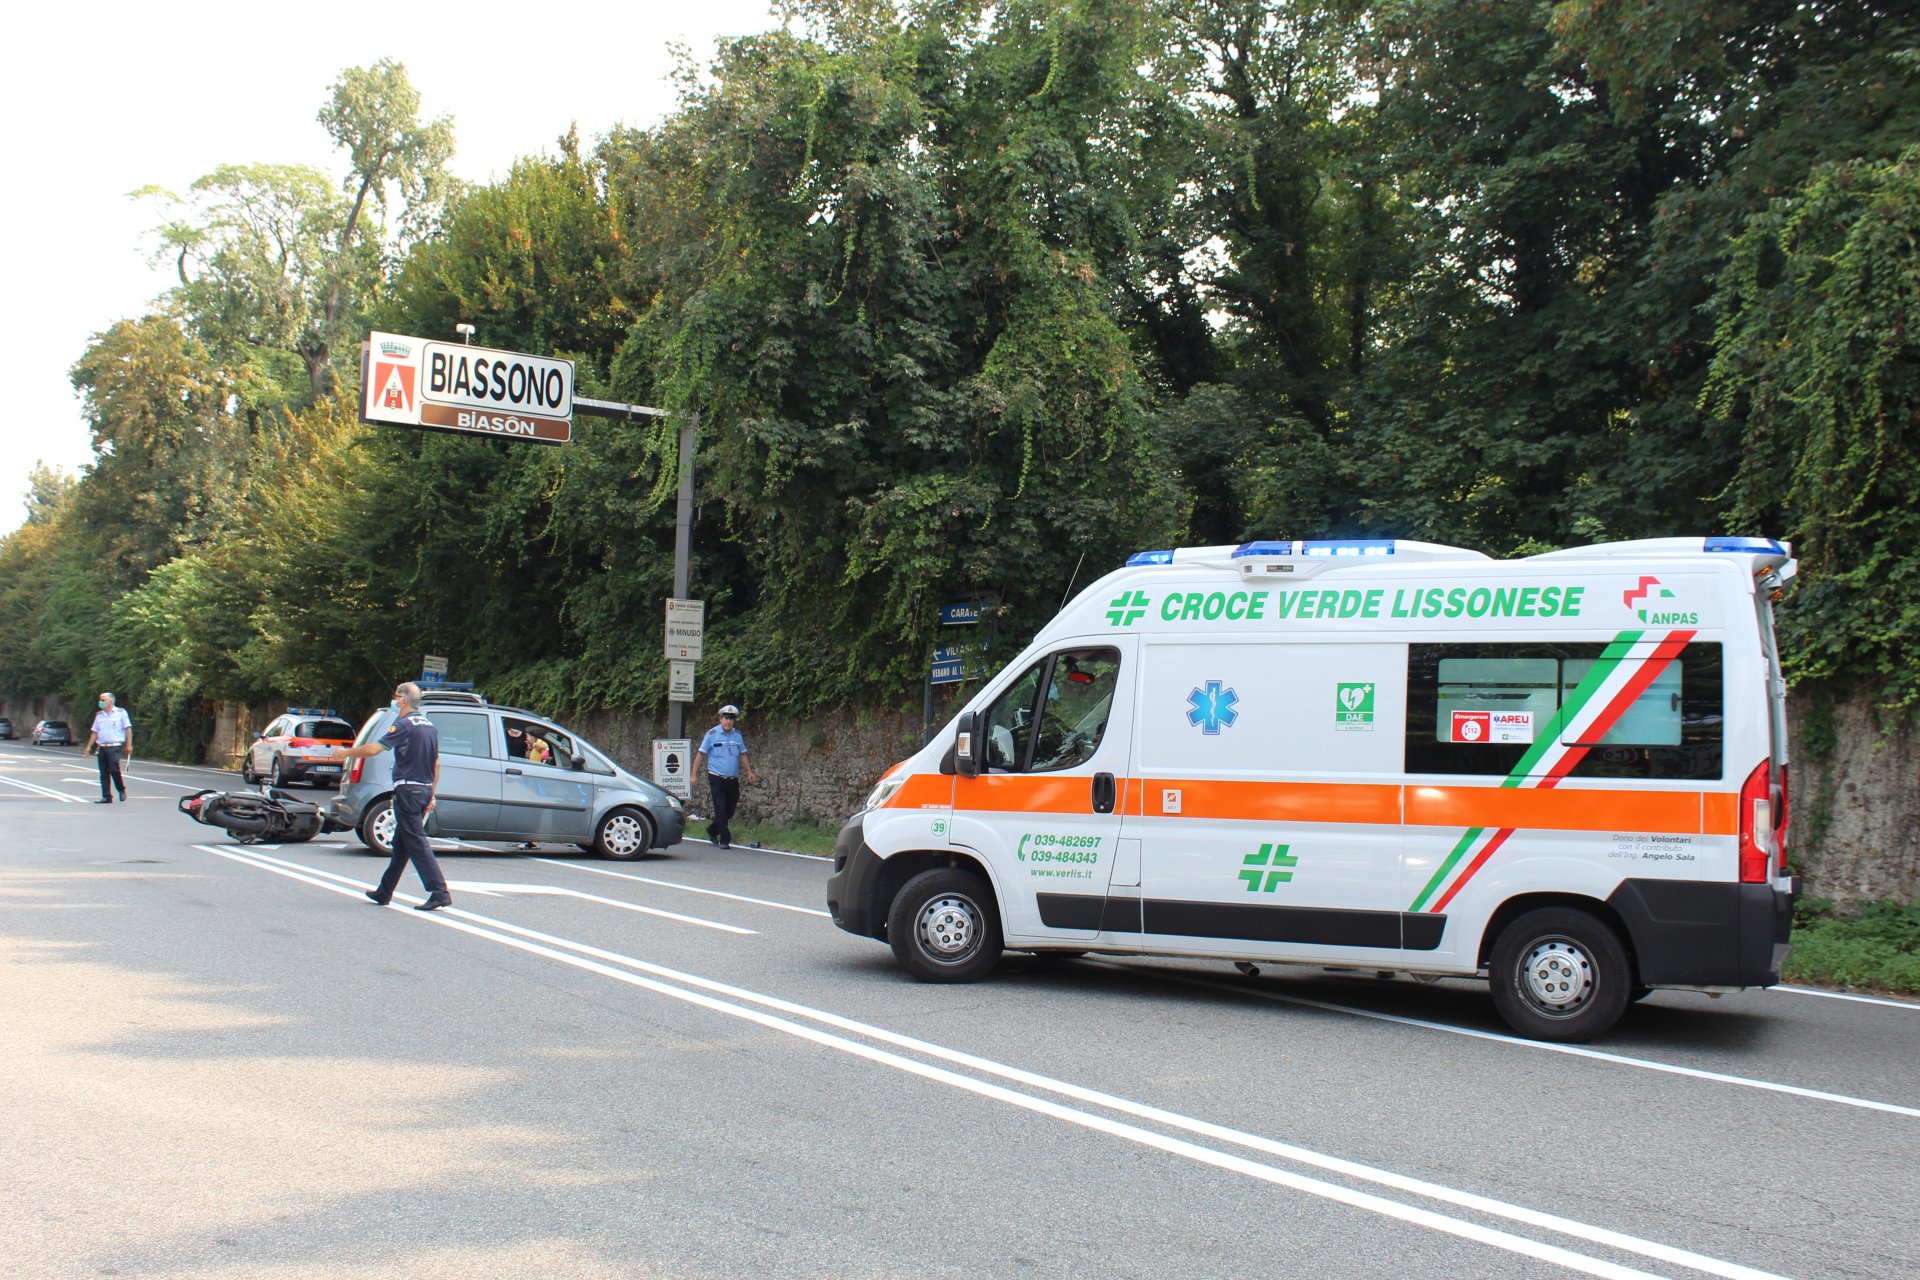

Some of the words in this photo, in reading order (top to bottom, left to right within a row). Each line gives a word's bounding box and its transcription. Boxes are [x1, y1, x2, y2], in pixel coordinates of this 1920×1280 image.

[430, 352, 563, 409] BIASSONO
[1160, 591, 1269, 621] CROCE
[1278, 589, 1385, 619] VERDE
[1390, 586, 1585, 619] LISSONESE
[1651, 612, 1698, 625] ANPAS
[676, 629, 700, 637] MINUSIO
[1500, 715, 1529, 723] AREU
[933, 822, 945, 832] 39
[1612, 834, 1633, 842] Dono
[1651, 836, 1692, 844] Volontari
[1642, 852, 1673, 861] Angelo
[1675, 853, 1695, 861] Sala
[1030, 869, 1092, 879] www.verlis.it
